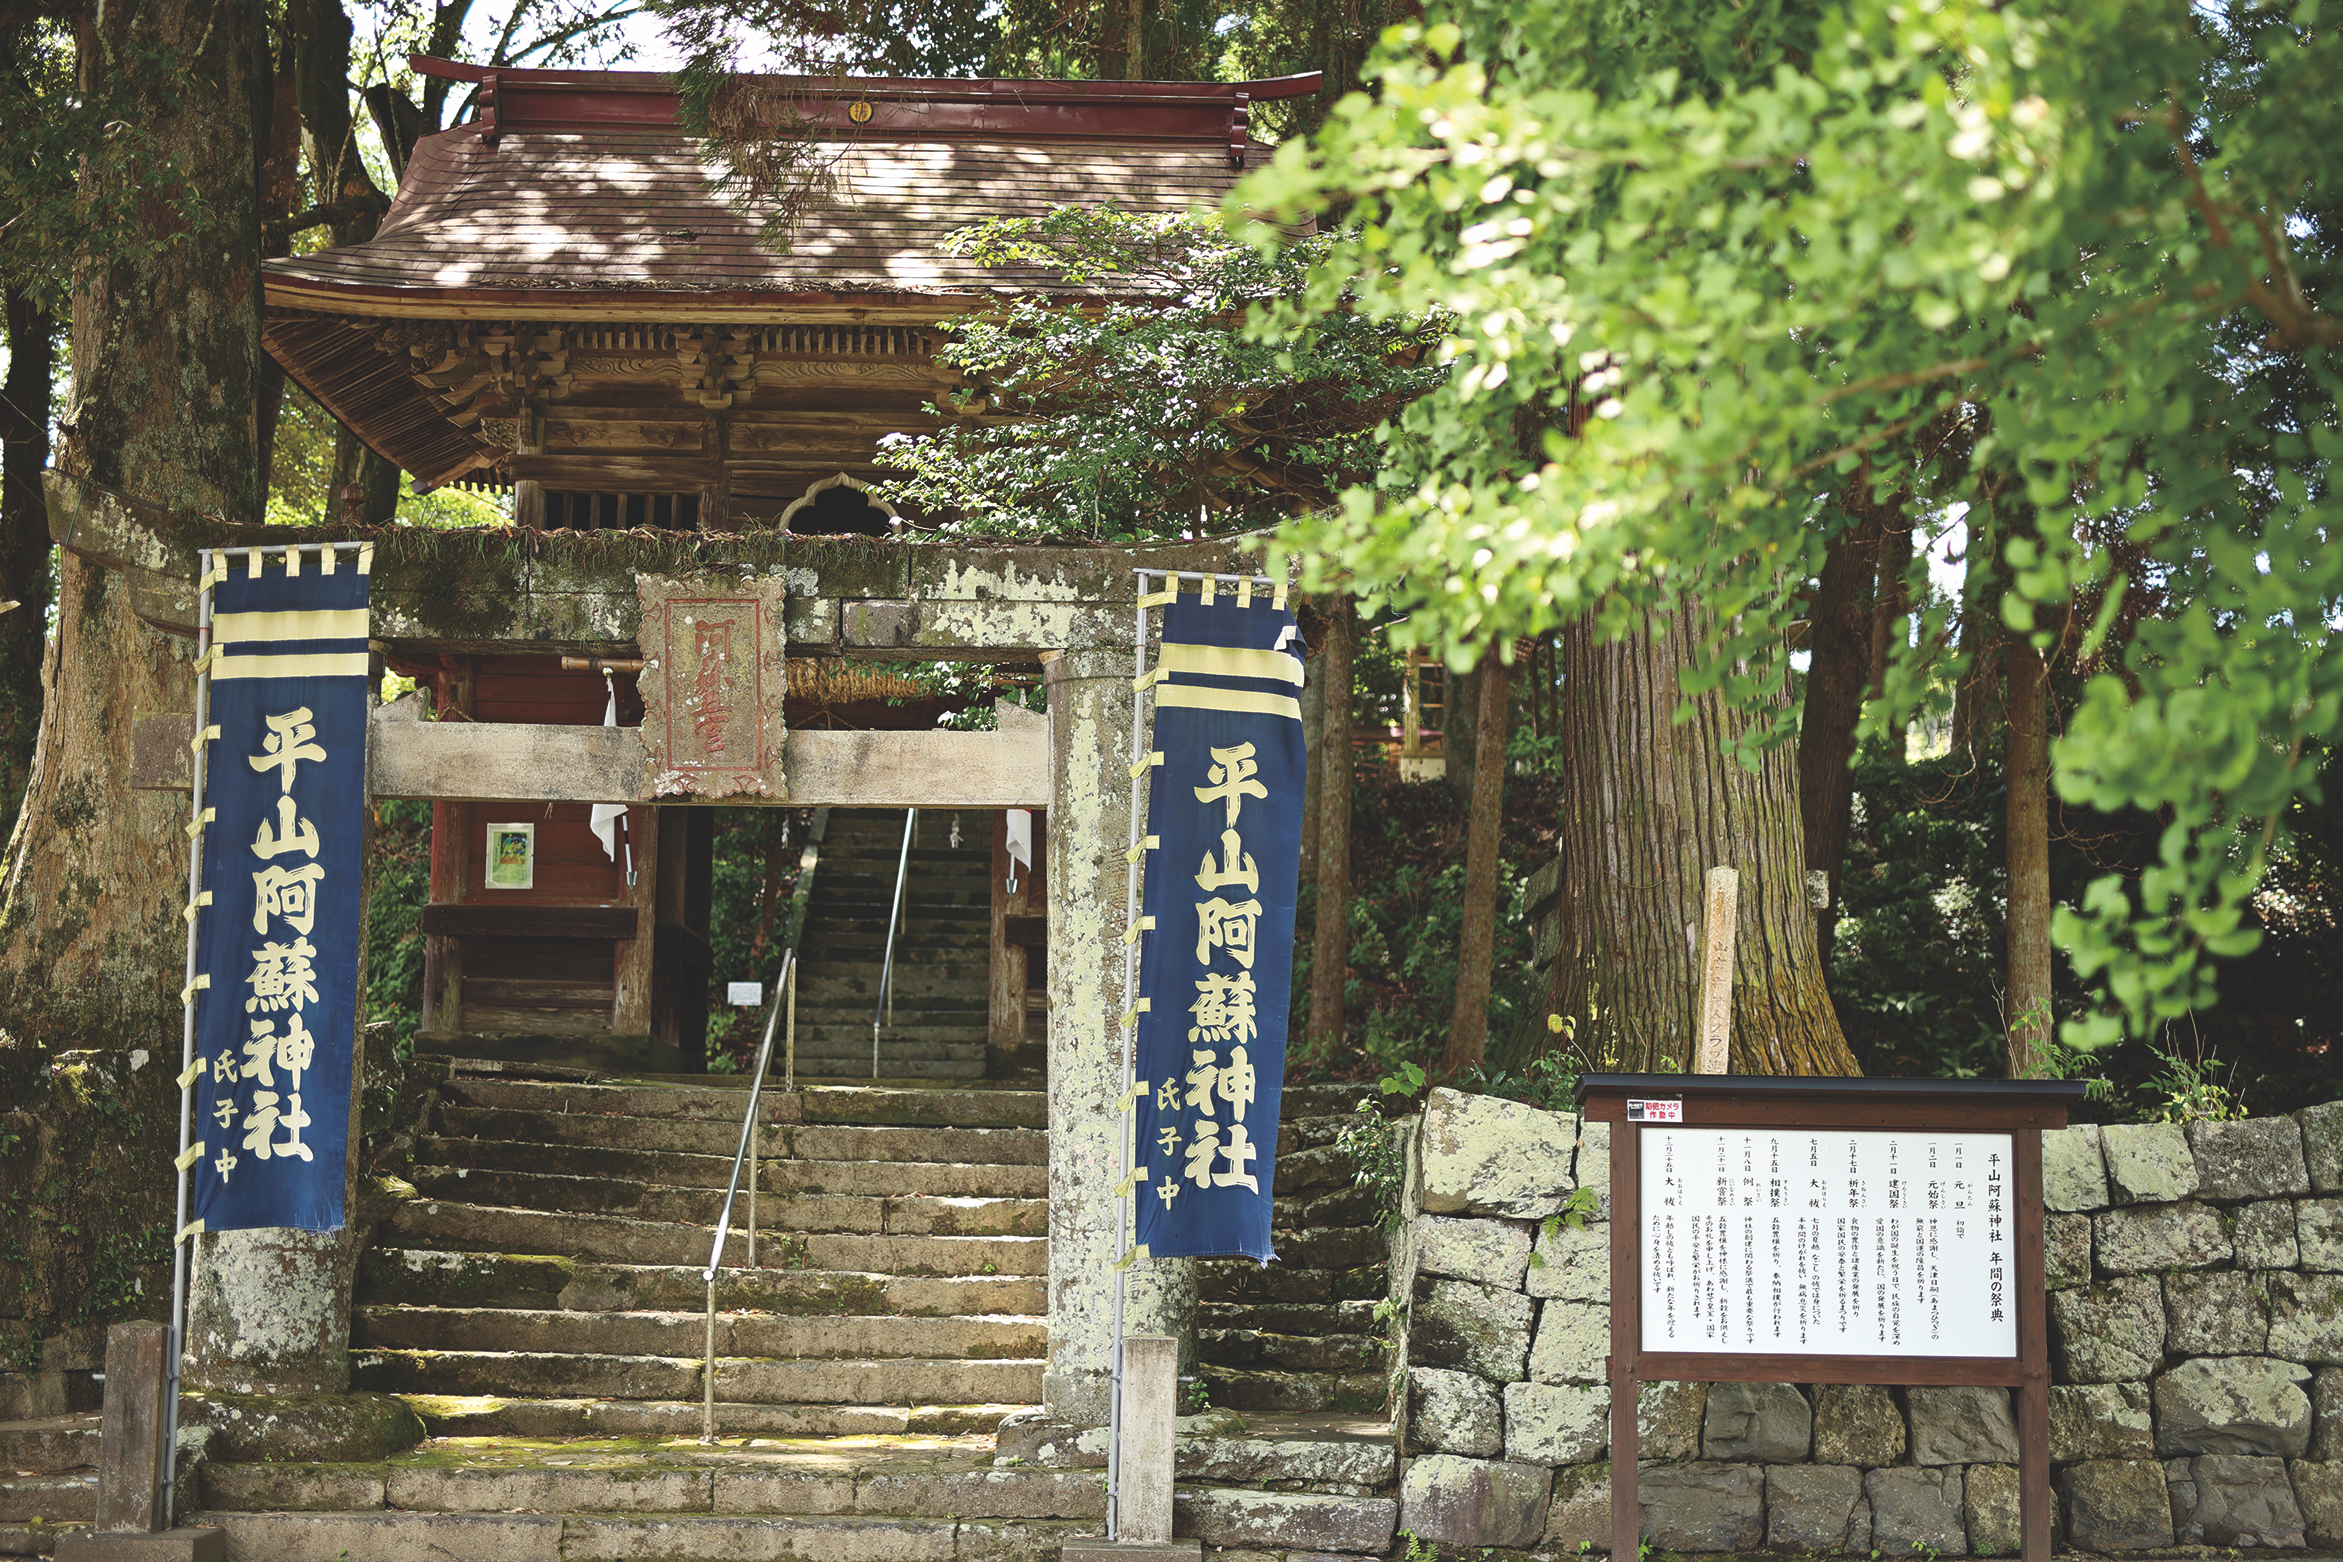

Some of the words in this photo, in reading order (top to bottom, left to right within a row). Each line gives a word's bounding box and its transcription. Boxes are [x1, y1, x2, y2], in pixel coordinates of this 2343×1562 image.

[240, 706, 327, 1162] 平山阿蘇神社
[1184, 741, 1268, 1195] 平山阿蘇神社
[213, 1049, 239, 1184] 氏子中
[1645, 1102, 1679, 1111] 防犯カメラ
[1649, 1111, 1676, 1119] 作動中
[1156, 1077, 1182, 1211] 氏子中
[1771, 1138, 1779, 1173] 九月十五日
[1810, 1139, 1818, 1166] 七月五日
[1849, 1140, 1857, 1173] 二月十七日
[1889, 1141, 1897, 1174] 二月十一日
[1929, 1143, 1937, 1168] 一月二日
[1664, 1177, 1674, 1206] 大祓
[1717, 1177, 1727, 1206] 新嘗祭
[1743, 1178, 1753, 1206] 例祭
[1770, 1178, 1780, 1207] 相撲祭
[1809, 1179, 1820, 1208] 大祓
[1849, 1179, 1859, 1208] 祈年祭
[1889, 1179, 1899, 1208] 建国祭
[1928, 1180, 1938, 1209] 元始祭
[1954, 1181, 1965, 1209] 元旦
[1988, 1154, 2002, 1243] 平山阿蘇神社
[1989, 1252, 2004, 1322] 年間の祭典
